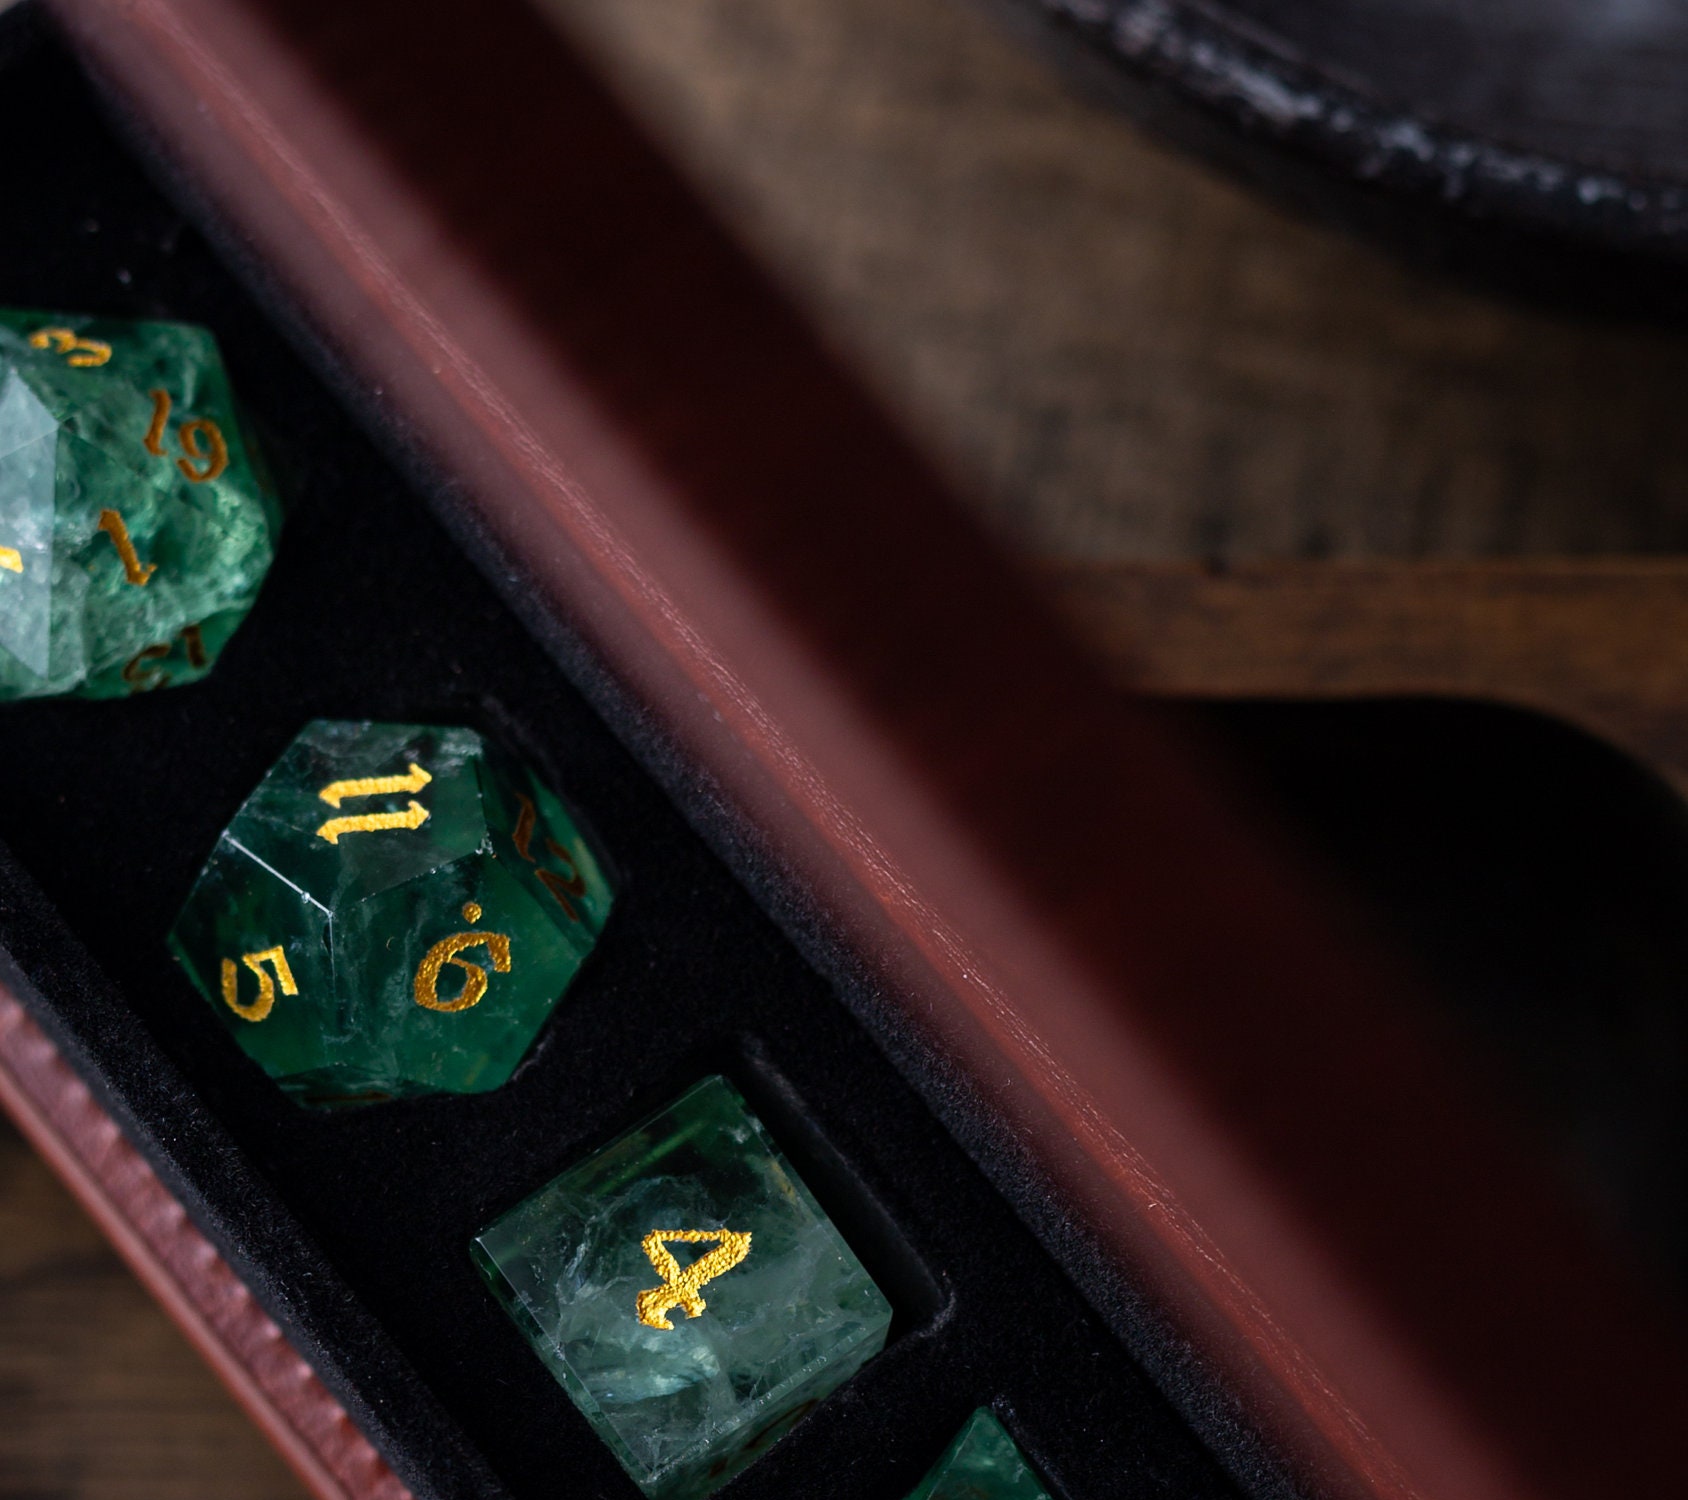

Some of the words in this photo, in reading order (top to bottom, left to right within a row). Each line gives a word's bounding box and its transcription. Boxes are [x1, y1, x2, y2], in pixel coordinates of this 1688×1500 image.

[29, 327, 112, 367] 3
[143, 388, 229, 483] 19
[98, 509, 157, 586] 1
[317, 762, 432, 844] 11
[221, 945, 299, 1023] 5
[635, 1228, 752, 1331] 4
